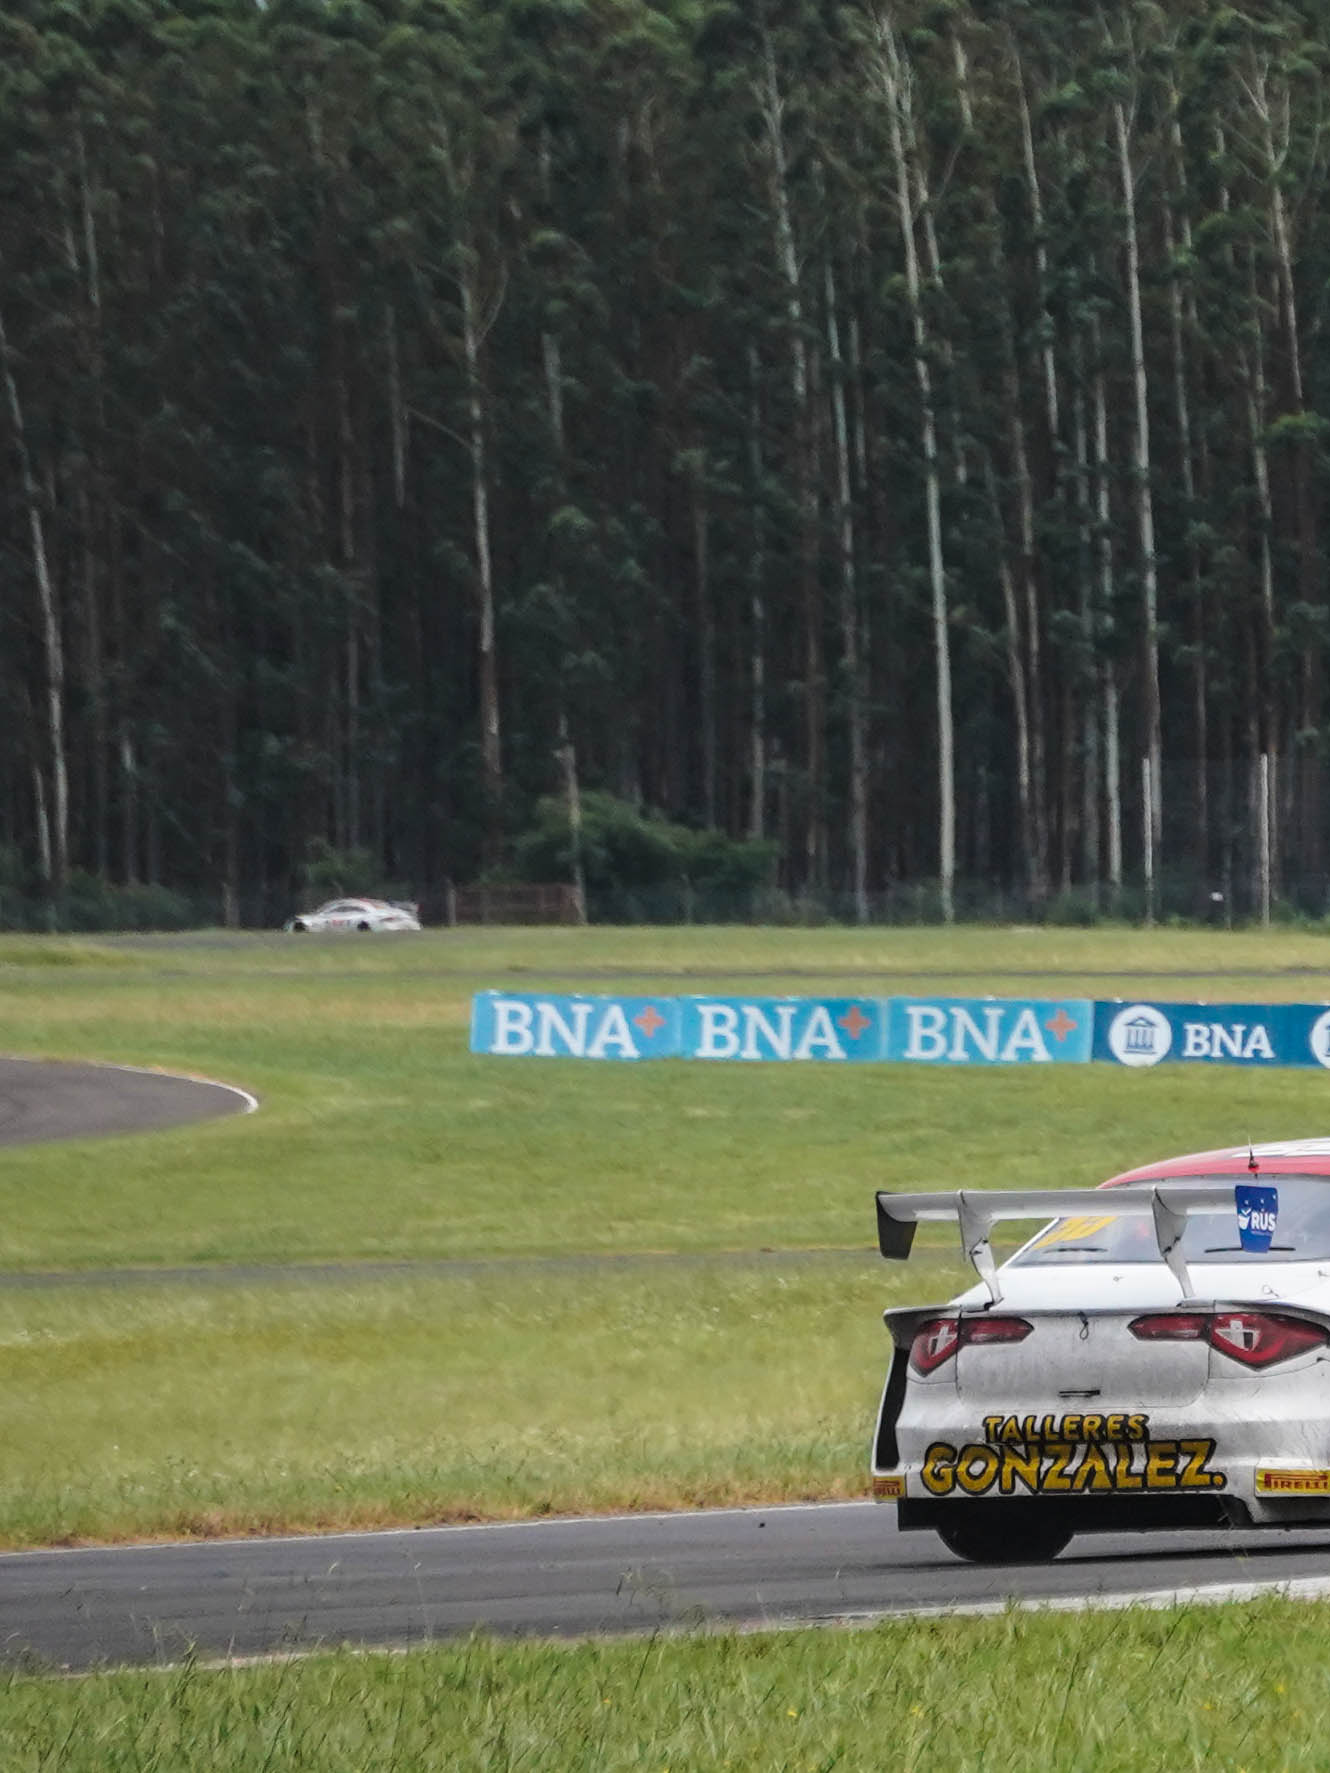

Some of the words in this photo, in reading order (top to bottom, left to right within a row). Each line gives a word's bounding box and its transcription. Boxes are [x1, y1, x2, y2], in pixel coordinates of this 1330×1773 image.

[1183, 1022, 1275, 1060] BNA
[984, 1415, 1149, 1443] TALLERES
[1264, 1473, 1328, 1490] PIRELLI
